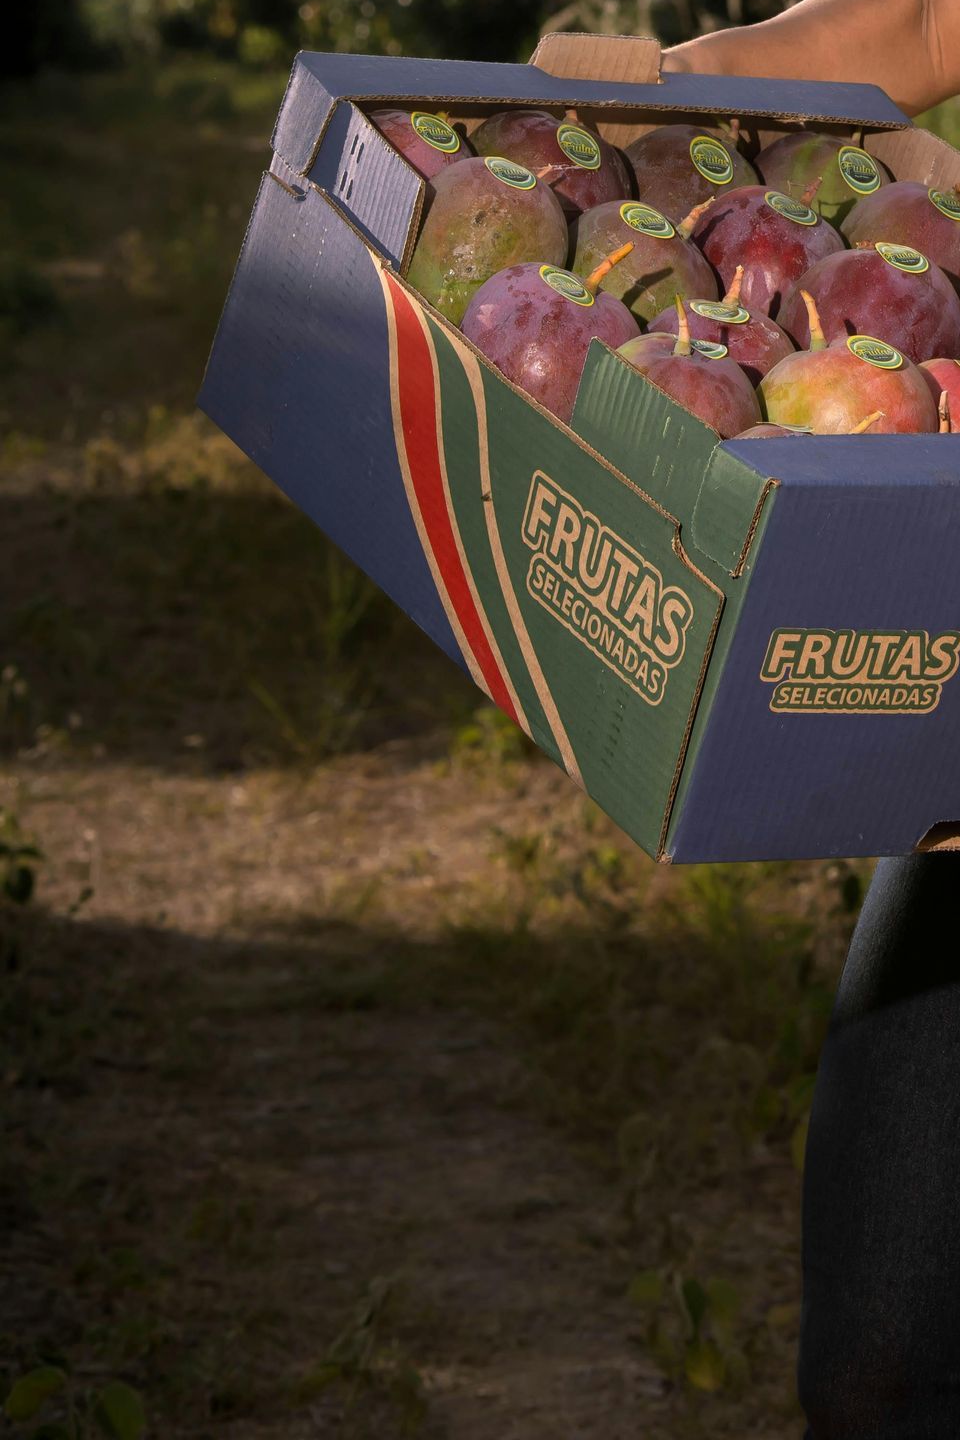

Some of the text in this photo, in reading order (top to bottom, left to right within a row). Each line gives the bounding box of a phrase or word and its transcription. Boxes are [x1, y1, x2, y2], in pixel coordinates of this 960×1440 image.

[527, 482, 686, 657] FRUTAS
[532, 563, 662, 694] SELECIONADAS
[767, 633, 957, 677] FRUTAS
[776, 686, 935, 706] SELECIONADAS
